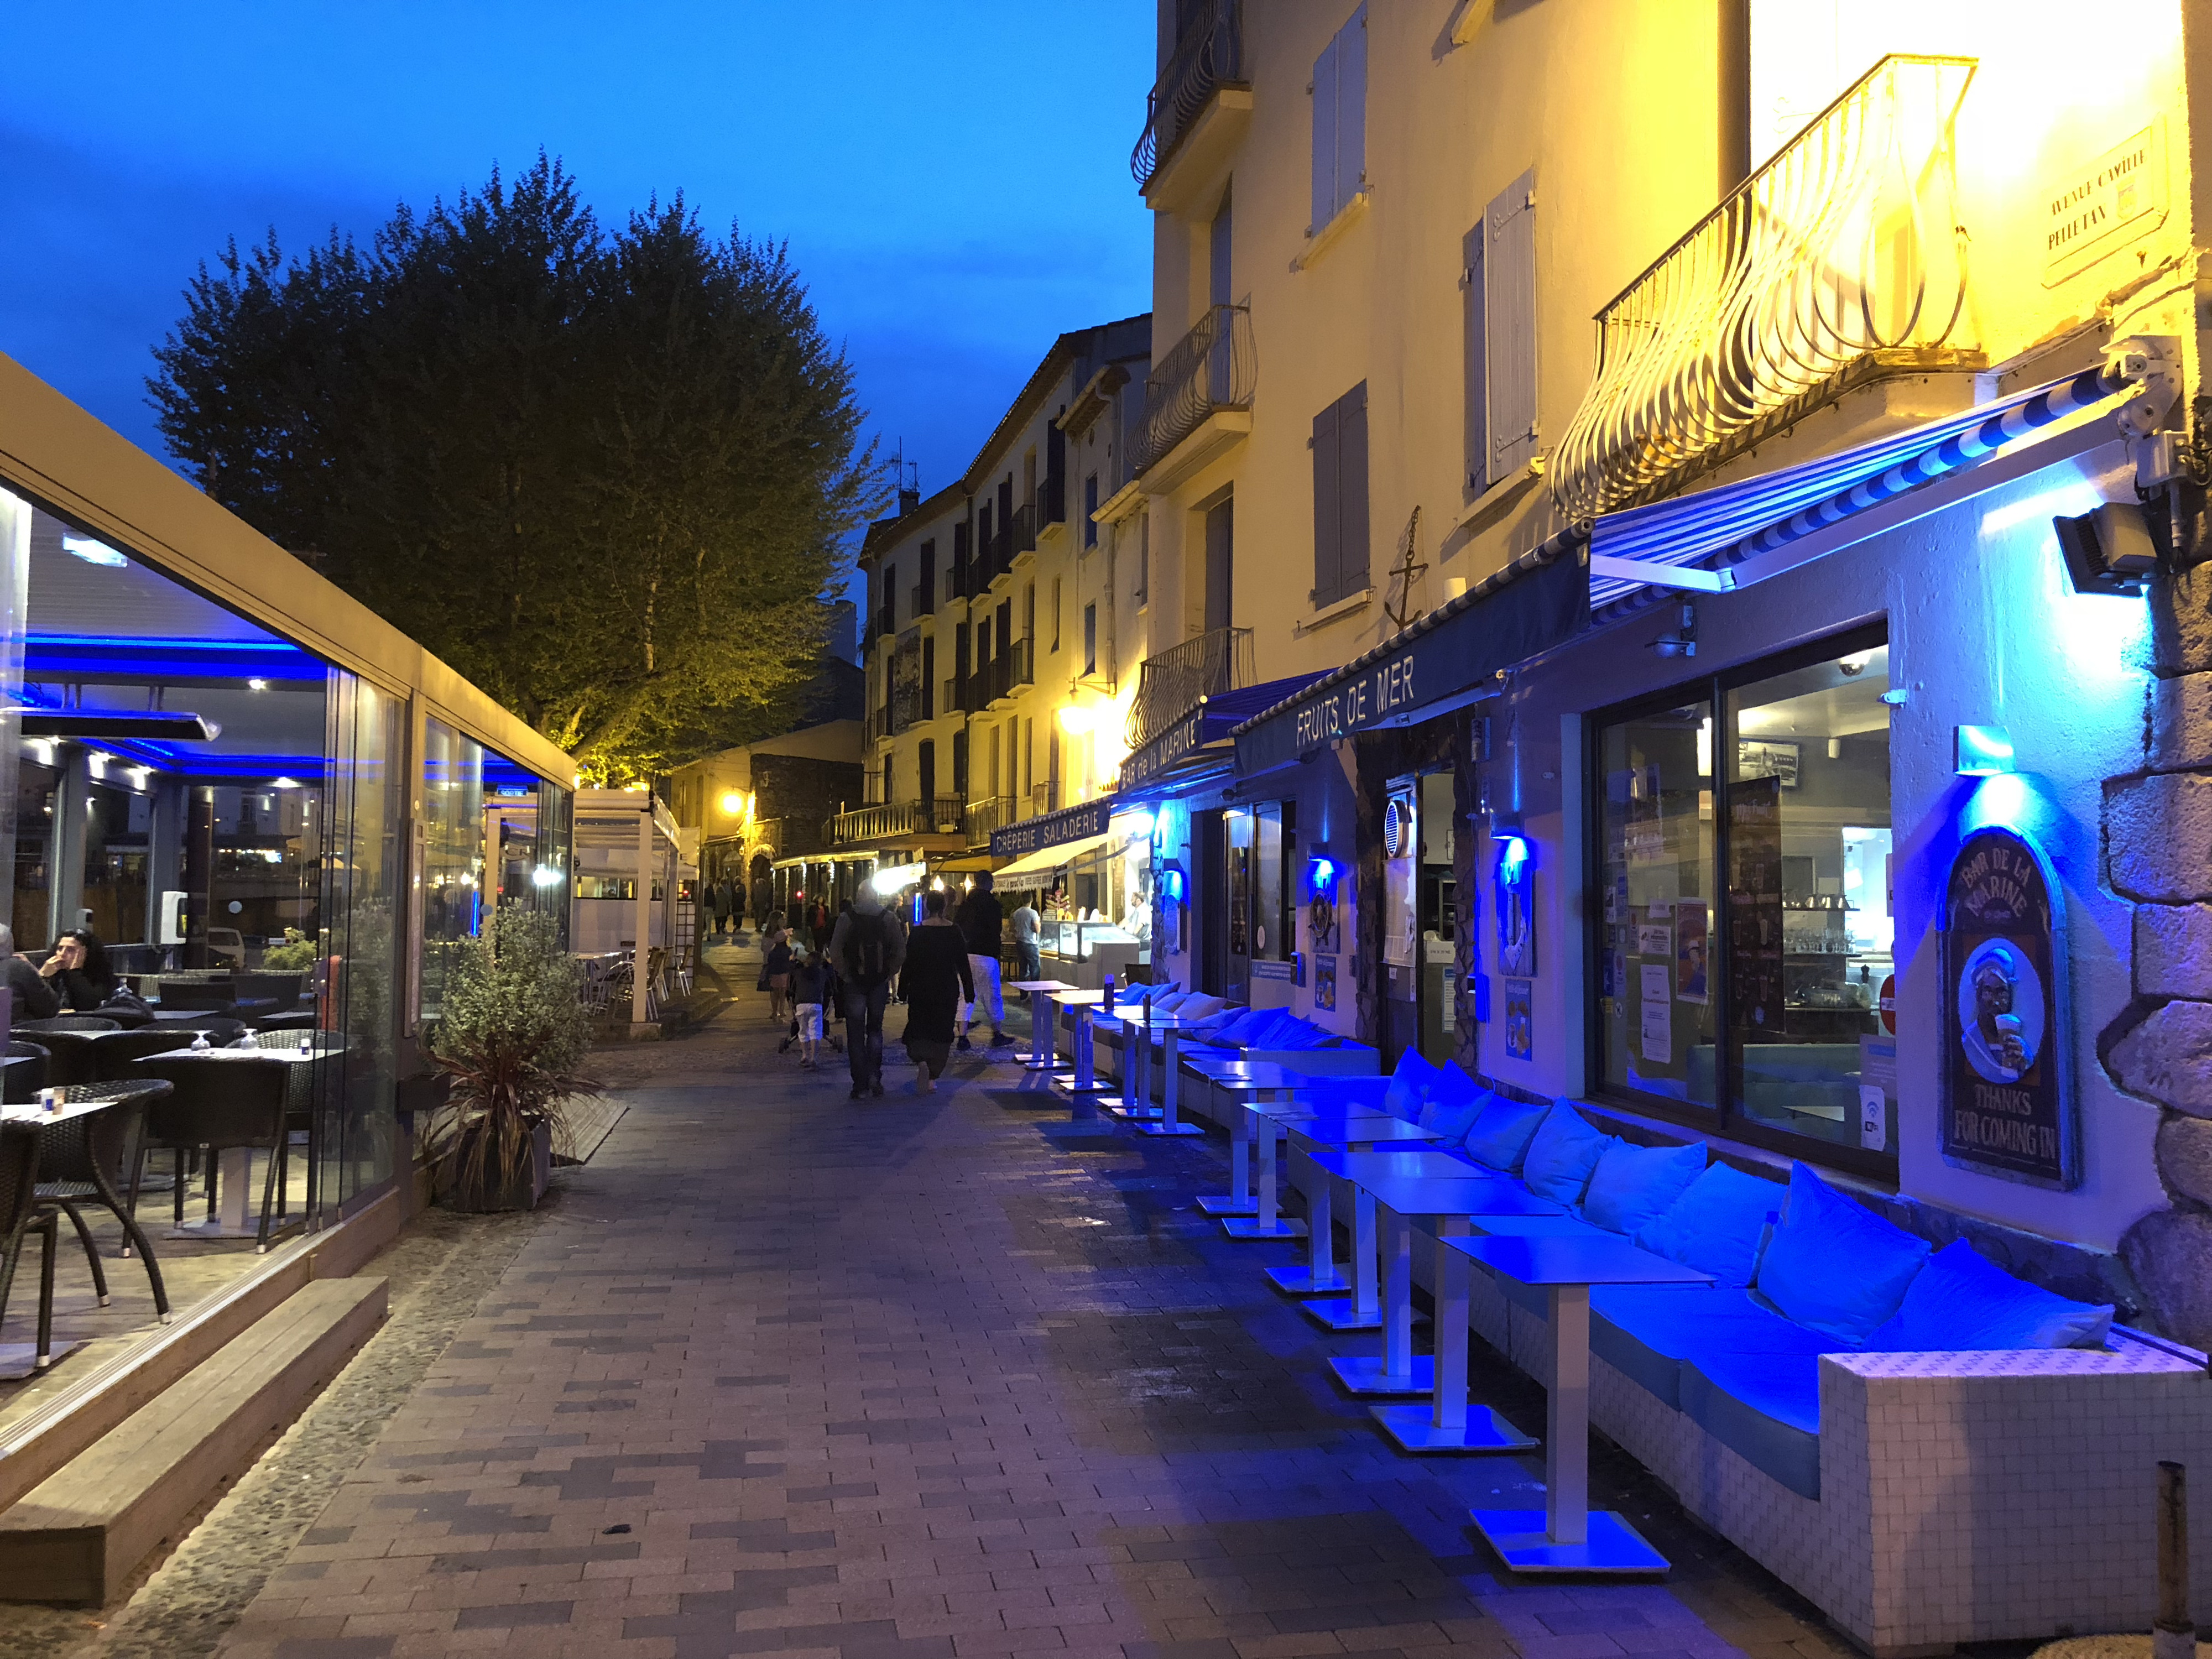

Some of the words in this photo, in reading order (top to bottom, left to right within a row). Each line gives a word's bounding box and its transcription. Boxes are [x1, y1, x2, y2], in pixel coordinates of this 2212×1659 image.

[2052, 180, 2093, 216] AVENUE
[2048, 203, 2106, 251] PELLETAN
[1296, 695, 1339, 748] FRUITS
[1347, 680, 1367, 728] DE
[1376, 655, 1415, 715] MER
[1121, 763, 1135, 790] BAR
[1138, 756, 1148, 780] de
[1150, 748, 1157, 772] la
[997, 830, 1036, 853] CRÊPERIE
[1044, 811, 1098, 844] SALADERIE
[1961, 852, 1989, 889] BAR
[1992, 847, 2010, 871] DE
[2013, 855, 2032, 888] LA
[1964, 875, 2027, 917] MARINE
[1975, 1084, 2032, 1116] THANKS
[1954, 1109, 1979, 1144] FOR
[1980, 1115, 2037, 1155] COMING
[2039, 1126, 2056, 1160] IN
